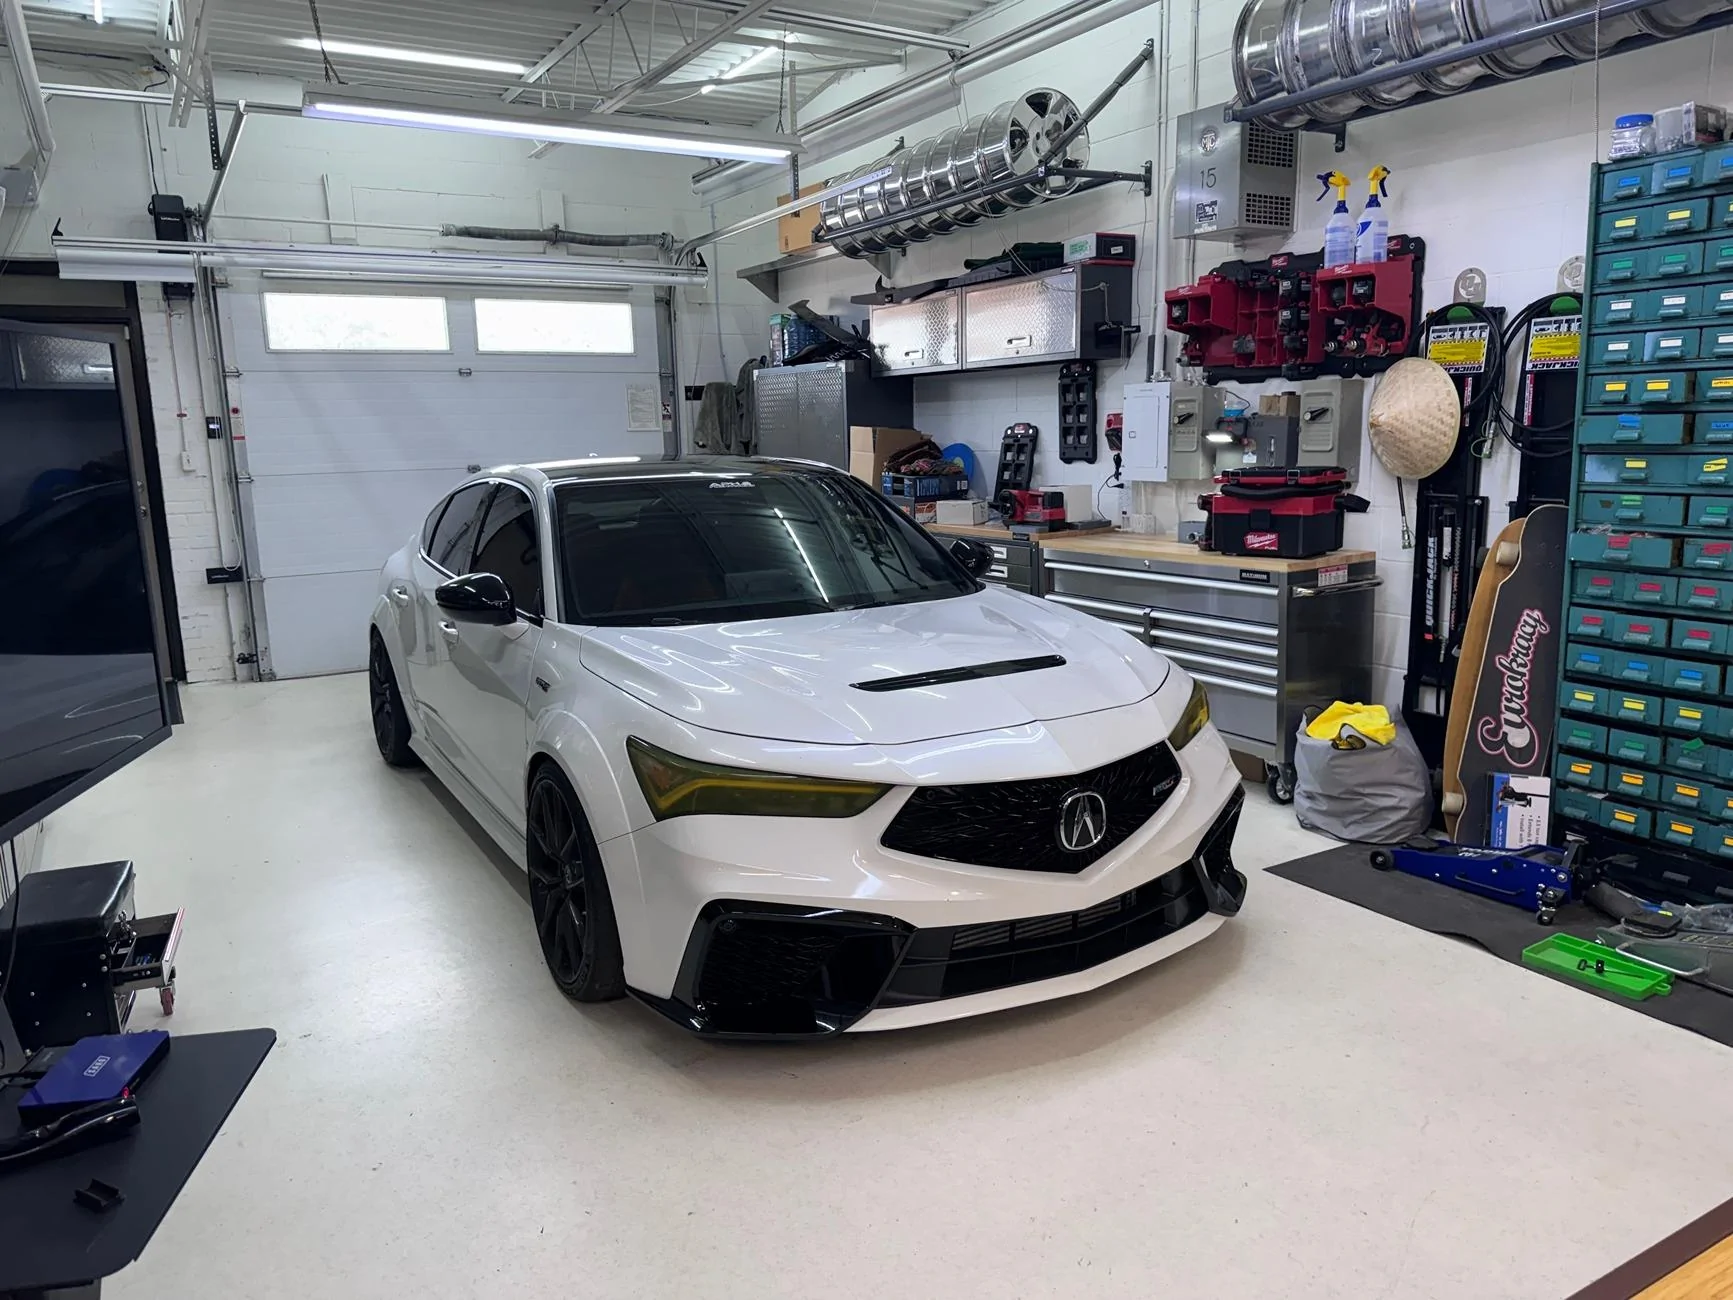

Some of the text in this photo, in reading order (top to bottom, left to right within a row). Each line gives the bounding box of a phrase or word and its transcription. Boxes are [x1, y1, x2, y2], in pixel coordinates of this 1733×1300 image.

[1200, 167, 1217, 190] 15
[1446, 365, 1482, 373] QUICKJ
[1531, 361, 1579, 370] ICKJACK
[1426, 537, 1434, 626] QUICKJACK
[1478, 609, 1550, 767] Eurokracy
